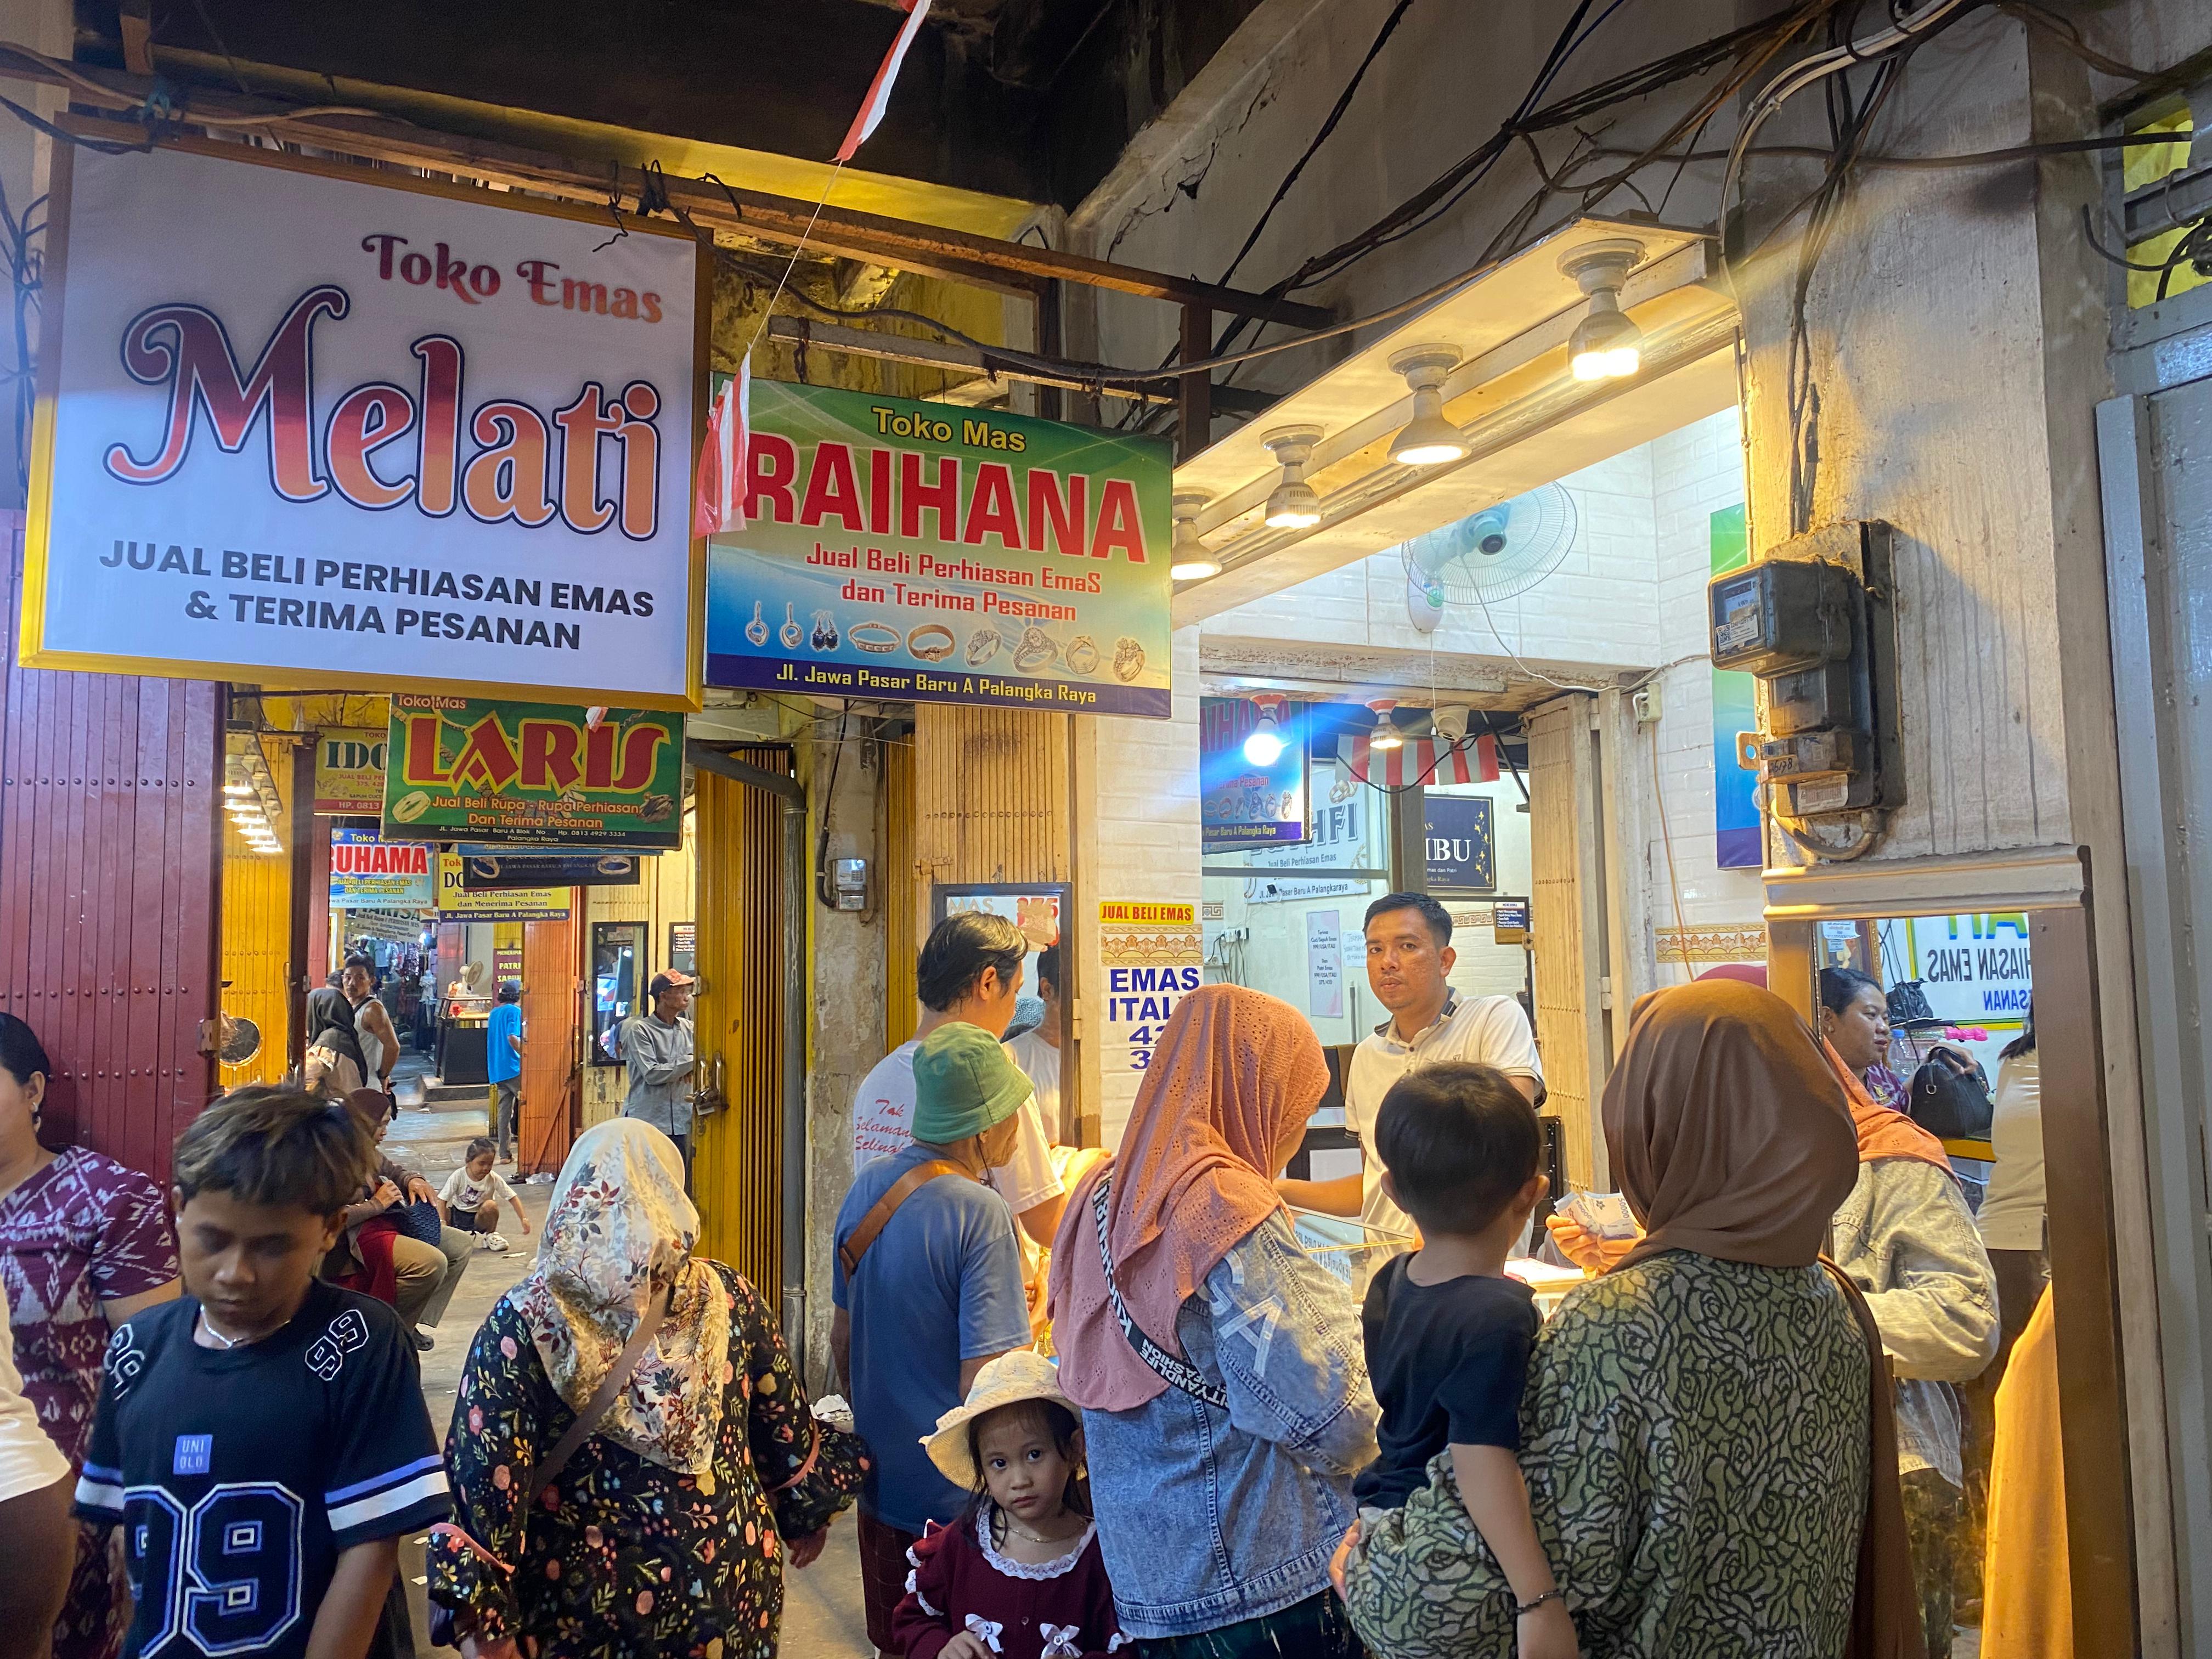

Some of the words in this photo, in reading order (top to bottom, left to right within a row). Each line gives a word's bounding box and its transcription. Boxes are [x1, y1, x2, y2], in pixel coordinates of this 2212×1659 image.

[361, 234, 500, 304] Toko
[516, 260, 663, 324] Emas
[103, 284, 662, 542] Melati
[872, 407, 952, 443] Toko
[963, 419, 1026, 453] Mas
[744, 432, 1149, 564] RAIHANA
[806, 543, 857, 569] Jual
[867, 549, 910, 574] Beli
[919, 554, 1033, 586] Perhiasan
[99, 540, 212, 578] JUAL
[222, 550, 304, 585] BELI
[315, 558, 540, 608] PERHIASAN
[550, 584, 654, 617] EMAS
[842, 578, 884, 605] dan
[893, 582, 975, 612] Terima
[984, 591, 1076, 621] Pesanan
[184, 590, 218, 622] &
[229, 594, 386, 634] TERIMA
[394, 613, 580, 651] PESANAN
[804, 667, 852, 687] Jawa
[858, 670, 910, 692] Pasar
[916, 673, 957, 693] Baru
[963, 678, 974, 695] A
[980, 678, 1053, 702] Palangka
[1058, 683, 1096, 703] Raya
[398, 694, 431, 707] Toko
[436, 696, 466, 709] Mas
[404, 711, 670, 794] LARIS
[1239, 775, 1269, 787] Pesanan
[433, 796, 460, 808] Jual
[465, 797, 487, 808] Beli
[492, 798, 526, 811] Rupa
[538, 800, 572, 812] Rupa
[577, 802, 639, 813] Perhiasan
[469, 813, 495, 824] Dan
[500, 814, 543, 826] Terima
[548, 816, 603, 828] Pesanan
[1238, 826, 1261, 836] Palangka
[1262, 825, 1276, 835] Raya
[350, 833, 375, 842] Toko
[1291, 856, 1319, 867] Perhiasan
[1321, 854, 1336, 862] Emas
[1312, 883, 1348, 894] Palangkaraya
[1102, 905, 1129, 919] JUAL
[1132, 906, 1157, 920] BELI
[1160, 907, 1192, 921] EMAS
[1110, 967, 1199, 992] EMAS
[1109, 996, 1182, 1022] ITAL
[1617, 1198, 1630, 1218] 50000
[182, 1439, 204, 1453] UNI
